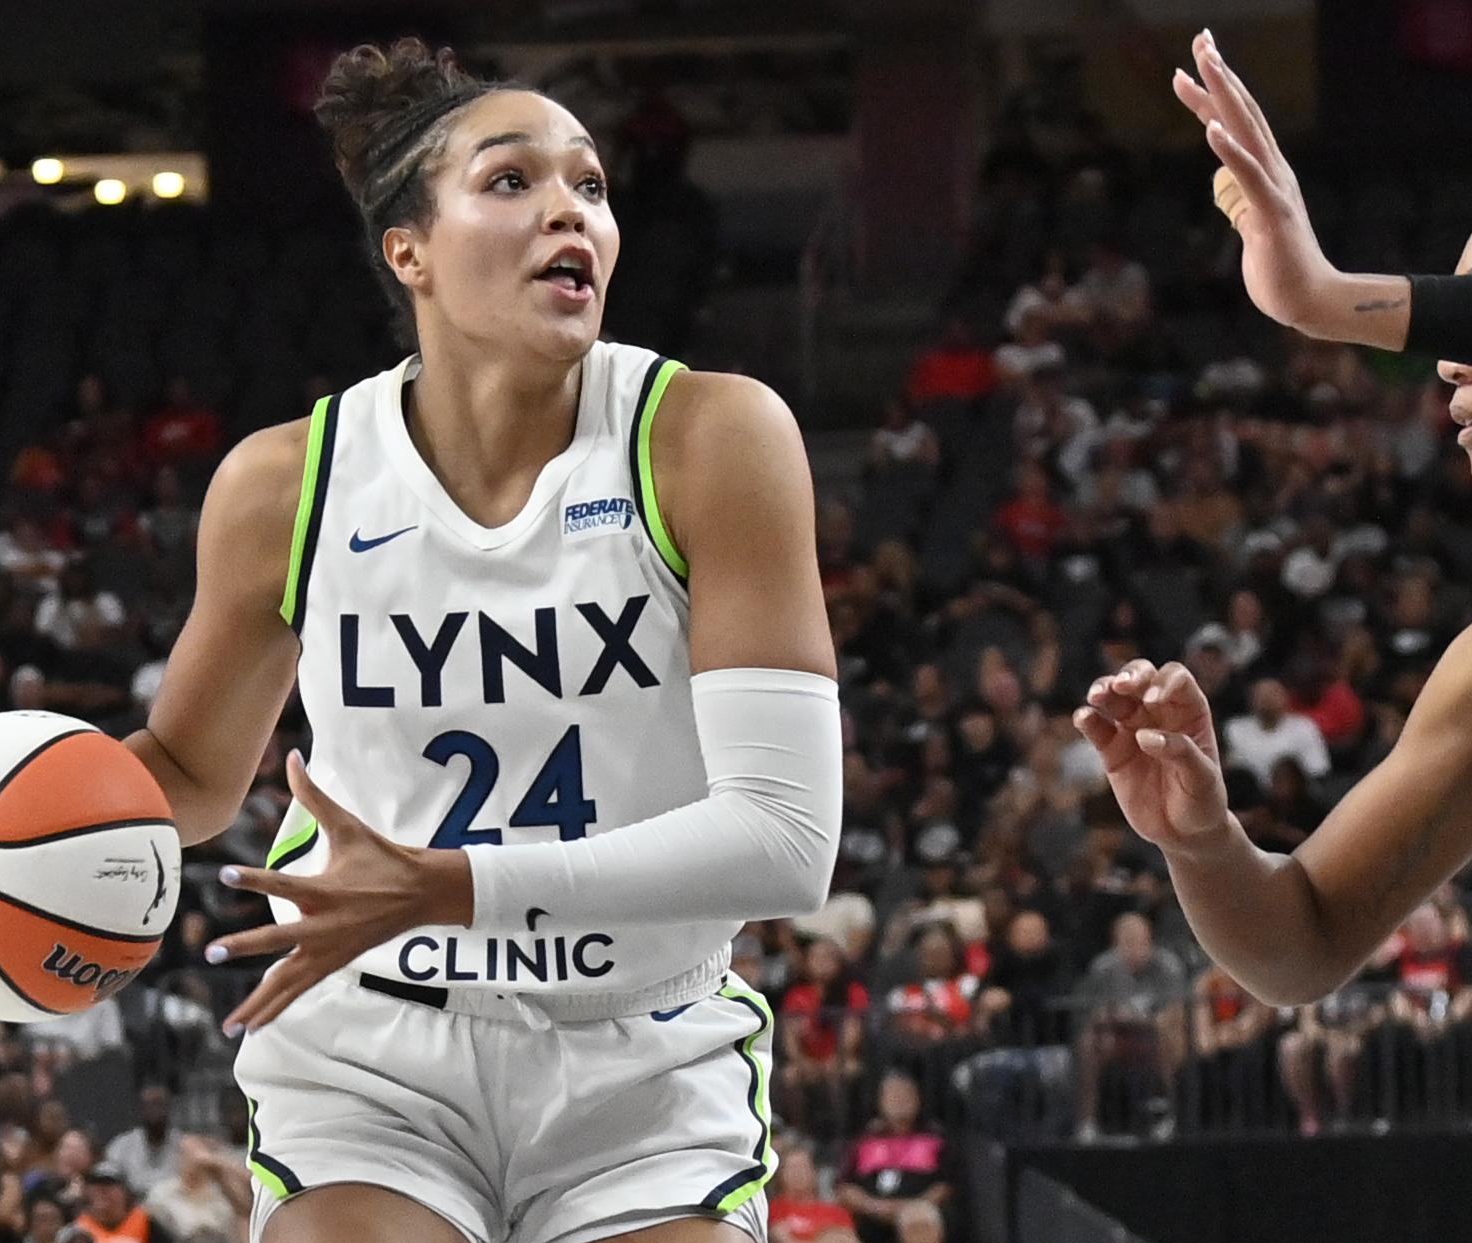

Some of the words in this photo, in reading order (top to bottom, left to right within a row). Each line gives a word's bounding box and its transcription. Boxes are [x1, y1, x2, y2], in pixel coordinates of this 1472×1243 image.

[564, 513, 620, 535] INSURANCE
[565, 497, 635, 523] FEDERATE
[339, 594, 661, 708] LYNX
[422, 724, 597, 850] 24
[398, 932, 616, 983] CLINIC
